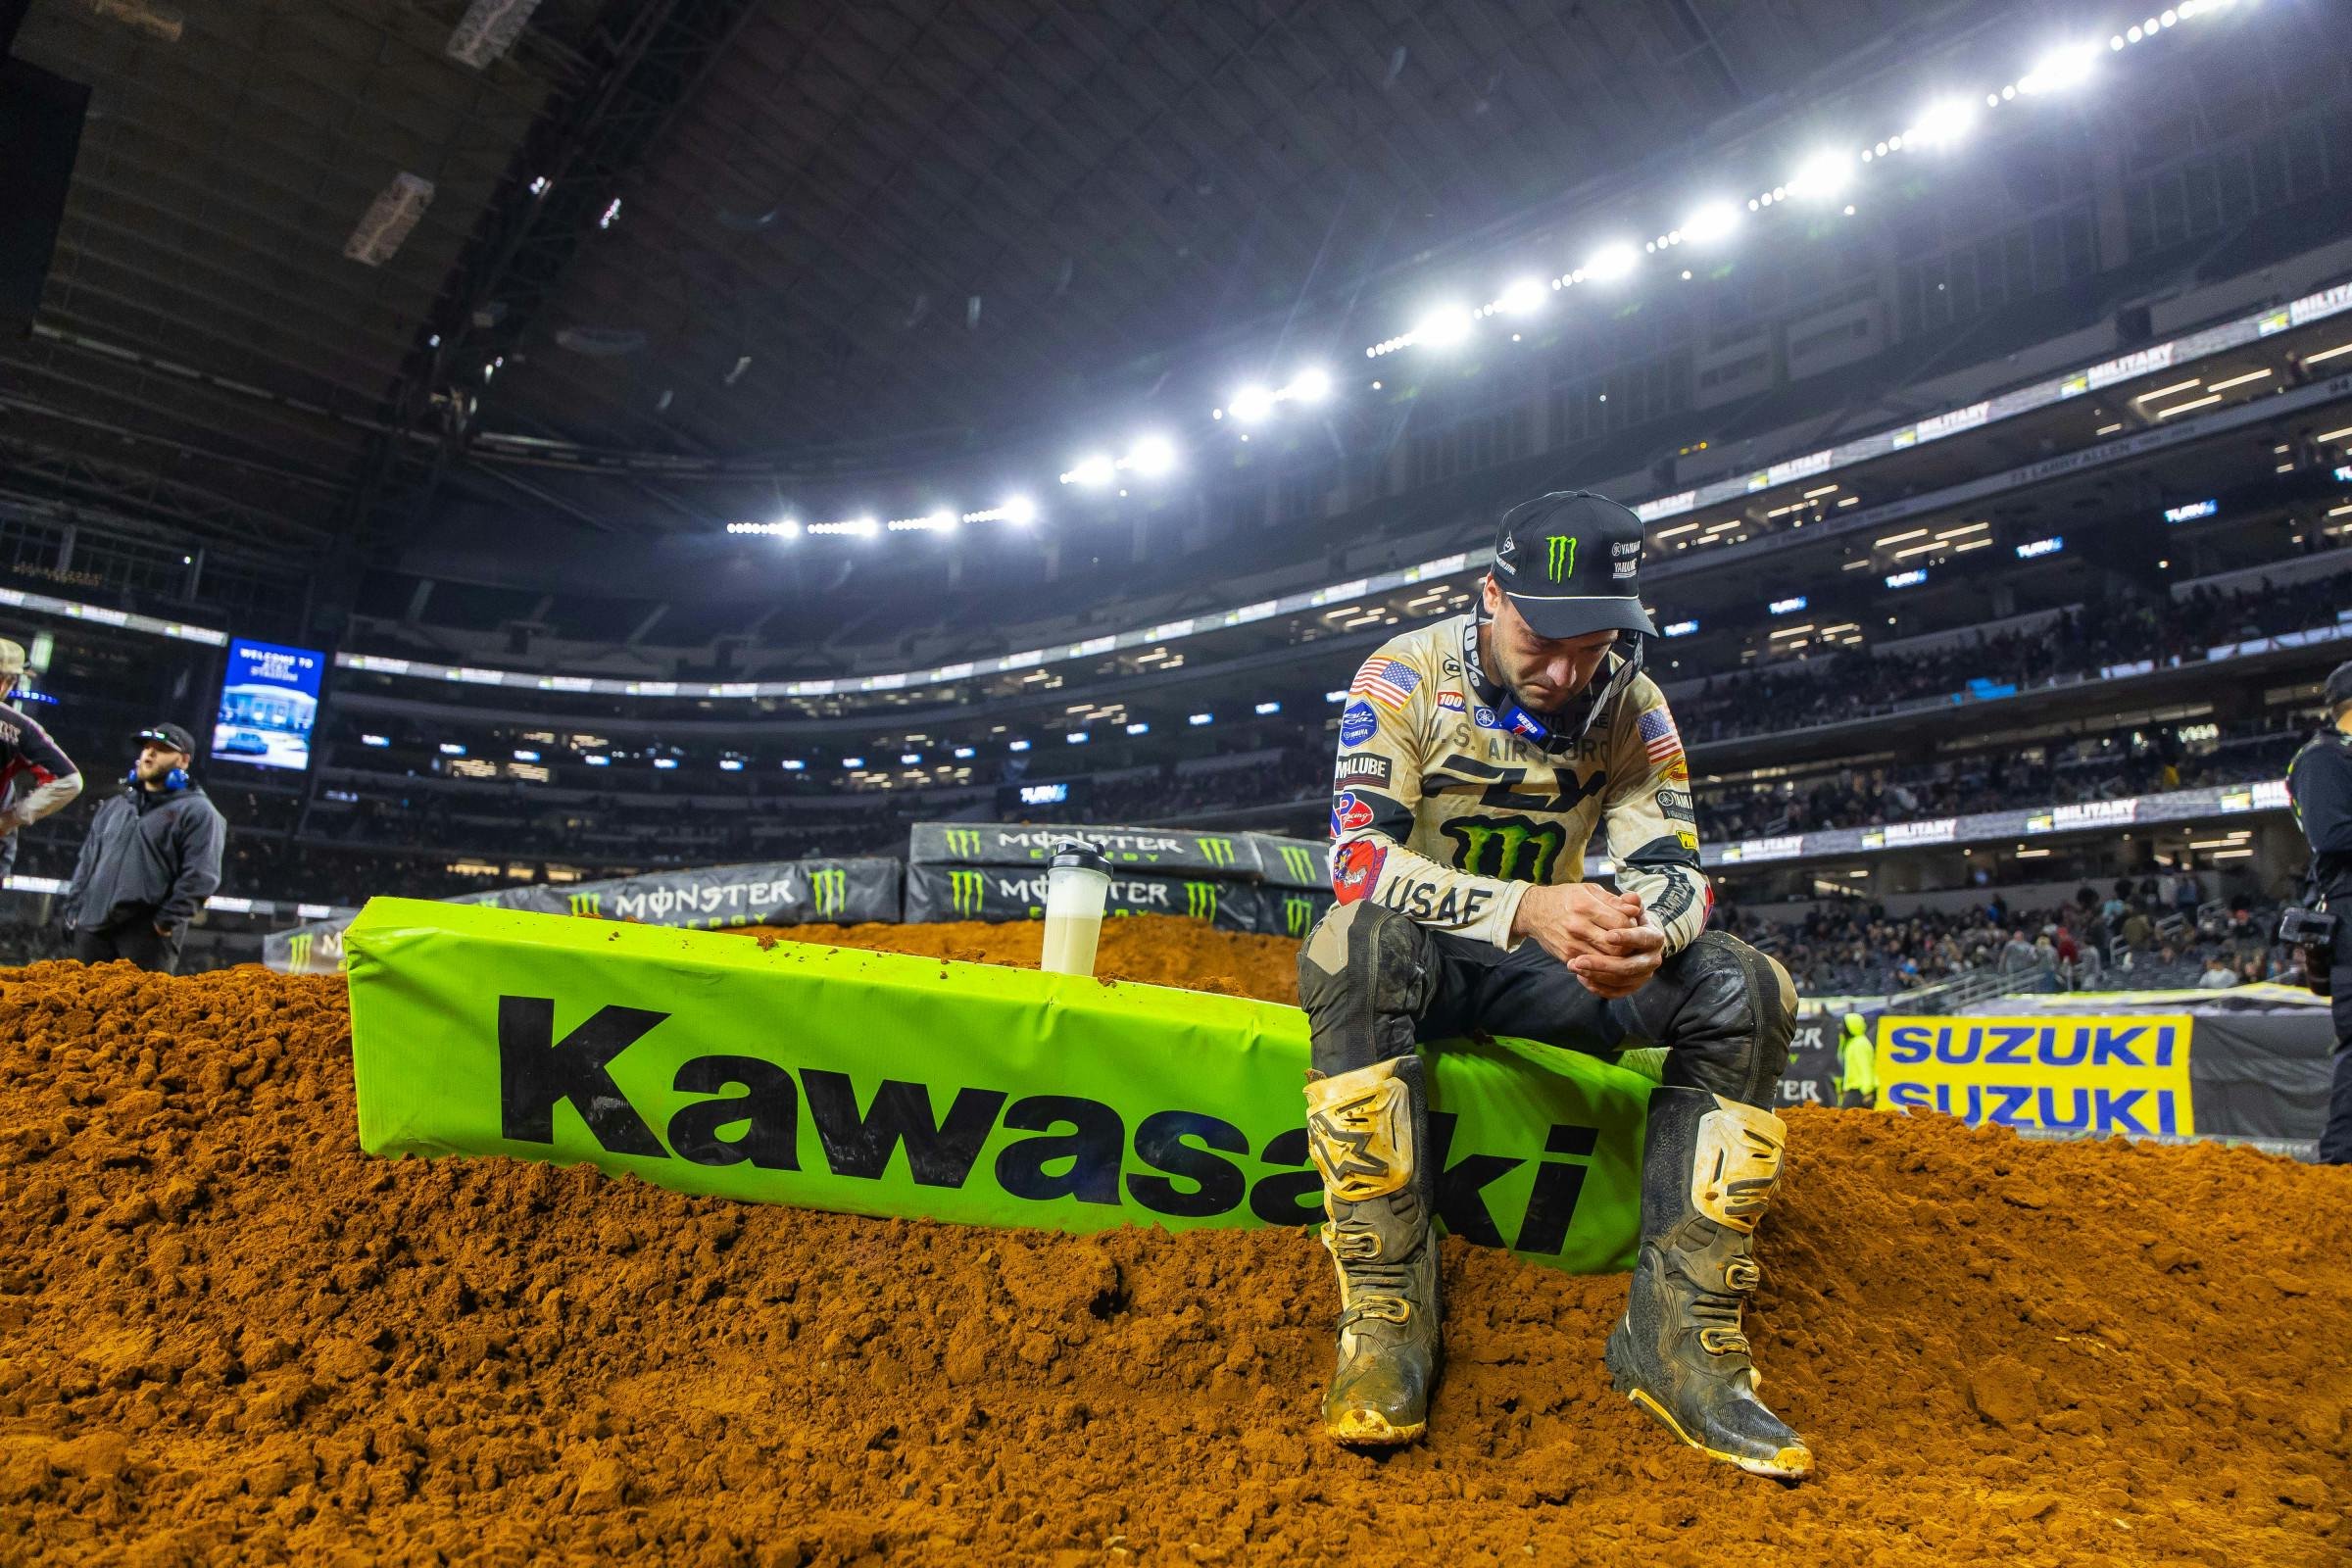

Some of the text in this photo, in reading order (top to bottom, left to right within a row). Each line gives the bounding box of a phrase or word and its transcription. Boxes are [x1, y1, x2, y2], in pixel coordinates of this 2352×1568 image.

[2087, 343, 2174, 381] MILITARY
[1517, 712, 1539, 735] WEBB
[1488, 737, 1528, 762] AIR
[1422, 754, 1607, 814] FLY
[2053, 798, 2136, 821] MILITARY
[614, 878, 796, 919] MONSTER
[999, 874, 1170, 907] MOTER
[1385, 875, 1494, 924] USAF
[1889, 1026, 2177, 1066] SUZUKI
[497, 994, 1599, 1256] Kawasaki
